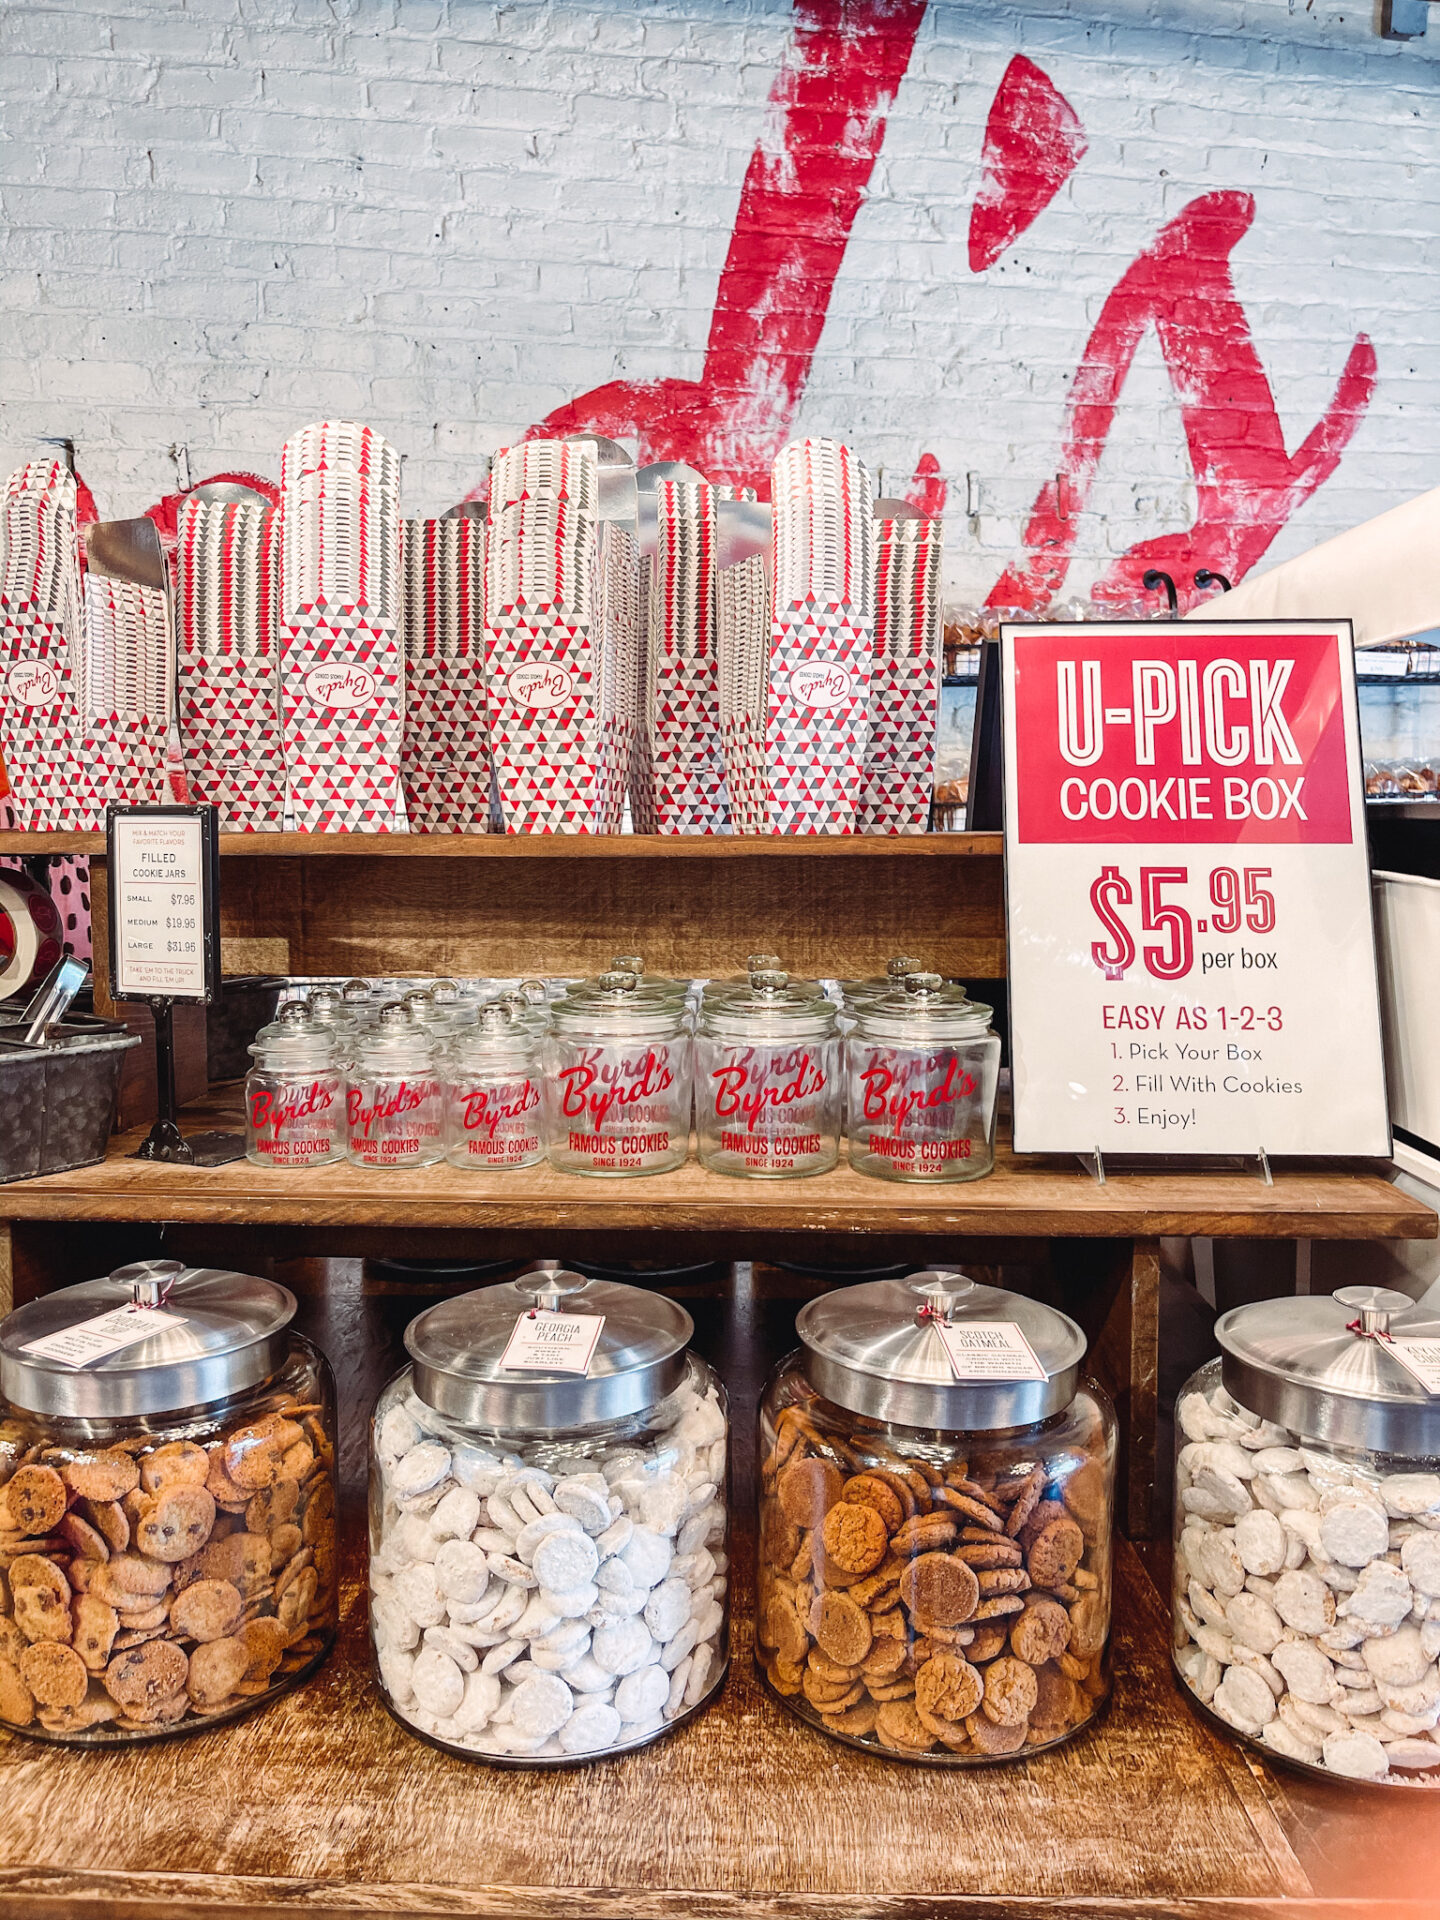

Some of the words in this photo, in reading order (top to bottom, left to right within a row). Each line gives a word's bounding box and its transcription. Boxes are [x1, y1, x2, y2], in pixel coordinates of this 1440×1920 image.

[16, 667, 54, 701] Byrd's
[315, 670, 369, 702] Byrd's
[517, 669, 567, 703] Byrd's
[799, 669, 846, 701] Byrd's
[1056, 657, 1303, 767] U-PICK
[1060, 777, 1212, 821] COOKIE
[1224, 777, 1308, 821] BOX
[141, 853, 176, 863] FILLED
[132, 868, 163, 878] COOKIE
[165, 869, 186, 878] JARS
[170, 893, 195, 905] $7.95
[165, 918, 196, 929] $19.95
[128, 942, 153, 950] LARGE
[166, 941, 196, 953] $31.95
[1201, 951, 1235, 974] per
[1241, 947, 1278, 970] box
[1102, 1004, 1166, 1031] EASY
[1176, 1004, 1208, 1031] AS
[1217, 1005, 1283, 1031] 1-2-3
[1111, 1042, 1123, 1060] 1.
[1129, 1041, 1169, 1061] Pick
[1175, 1043, 1219, 1061] Your
[1226, 1043, 1262, 1061] Box
[558, 1052, 675, 1132] Byrd's
[711, 1053, 827, 1132] Byrd's
[1113, 1075, 1129, 1093] 2.
[1135, 1074, 1164, 1094] Fill
[1169, 1074, 1216, 1094] With
[1222, 1075, 1303, 1094] Cookies
[859, 1056, 978, 1136] Byrd's
[249, 1081, 334, 1138] Byrd's
[346, 1081, 424, 1138] Byrd's
[460, 1079, 541, 1139] Byrd's
[1113, 1107, 1131, 1125] 3.
[1136, 1107, 1197, 1130] Enjoy!
[293, 1138, 330, 1155] COOKIES
[382, 1139, 419, 1154] COOKIES
[468, 1139, 505, 1155] FAMOUS
[508, 1136, 539, 1153] COOKIES
[569, 1131, 616, 1154] FAMOUS
[621, 1131, 669, 1154] COOKIES
[721, 1131, 769, 1155] FAMOUS
[774, 1132, 821, 1155] COOKIES
[868, 1134, 916, 1159] FAMOUS
[921, 1139, 971, 1160] COOKIES
[487, 1156, 504, 1164] SINCE
[506, 1155, 523, 1163] 1924
[592, 1157, 616, 1167] SINCE
[618, 1157, 642, 1167] 1924
[745, 1158, 768, 1168] SINCE
[771, 1158, 794, 1168] 1924
[892, 1161, 916, 1172] SINCE
[918, 1163, 942, 1173] 1924
[534, 1321, 581, 1334] GEORGIA
[536, 1332, 573, 1342] PEACH
[959, 1330, 1005, 1340] SCOTCH
[960, 1339, 1013, 1349] OATMEAL
